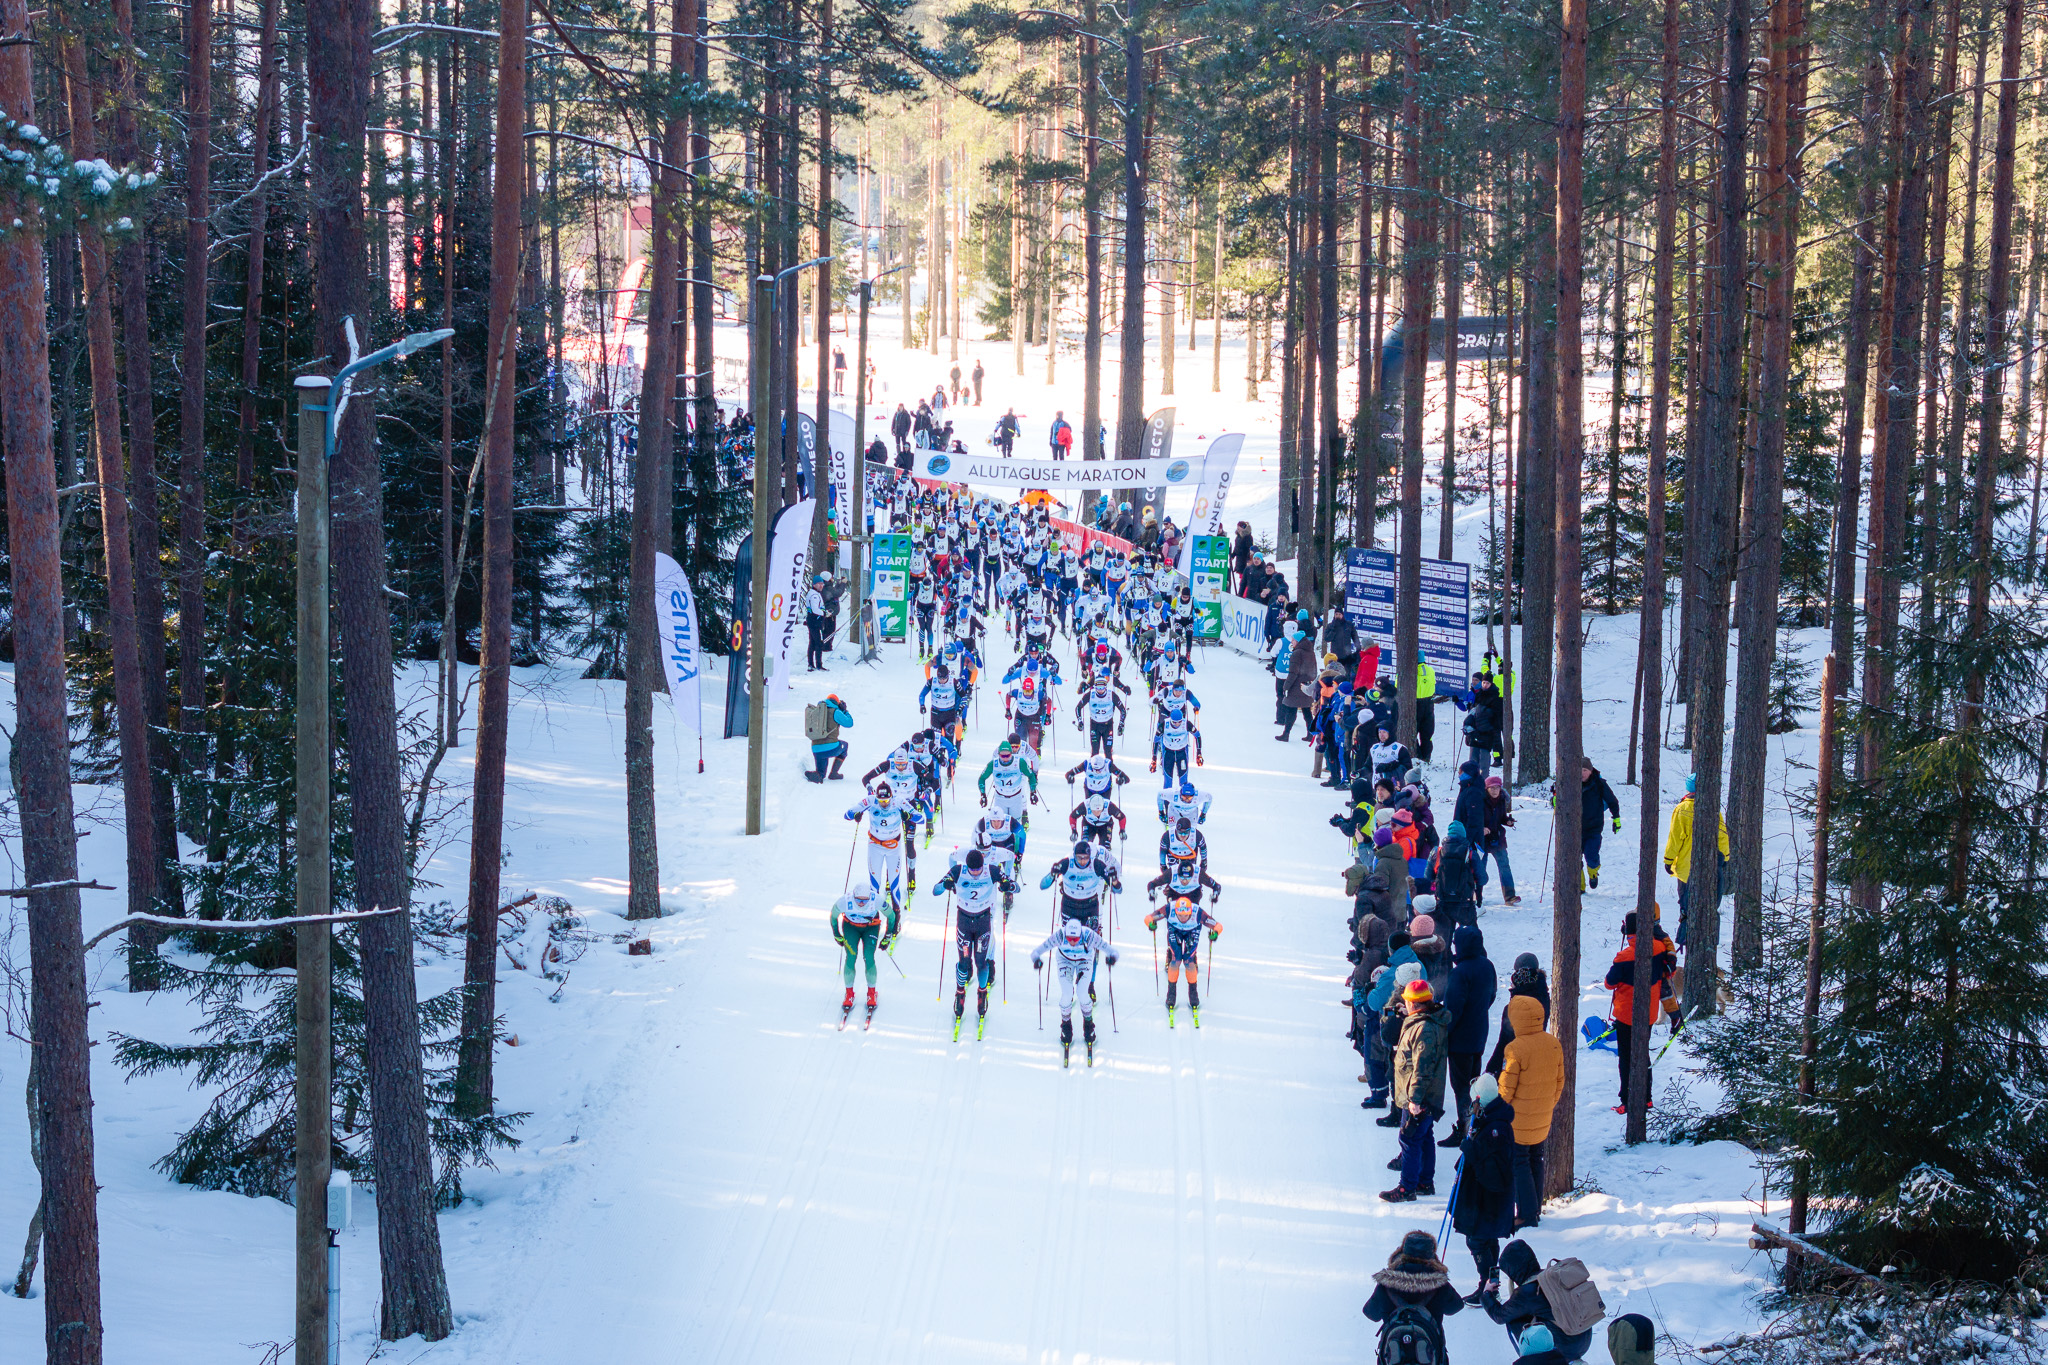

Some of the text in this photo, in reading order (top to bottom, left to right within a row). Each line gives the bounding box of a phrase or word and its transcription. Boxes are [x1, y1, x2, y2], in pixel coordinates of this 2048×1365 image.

[1145, 418, 1164, 501] COECTO
[968, 464, 1146, 482] ALUTAGUSE MARATON
[1206, 472, 1230, 536] NNECTO
[875, 556, 909, 567] START
[1194, 557, 1227, 569] START
[1236, 609, 1266, 653] sunly
[1001, 779, 1013, 787] 14
[880, 819, 888, 827] 8
[1076, 883, 1085, 891] 5
[969, 890, 979, 900] 2
